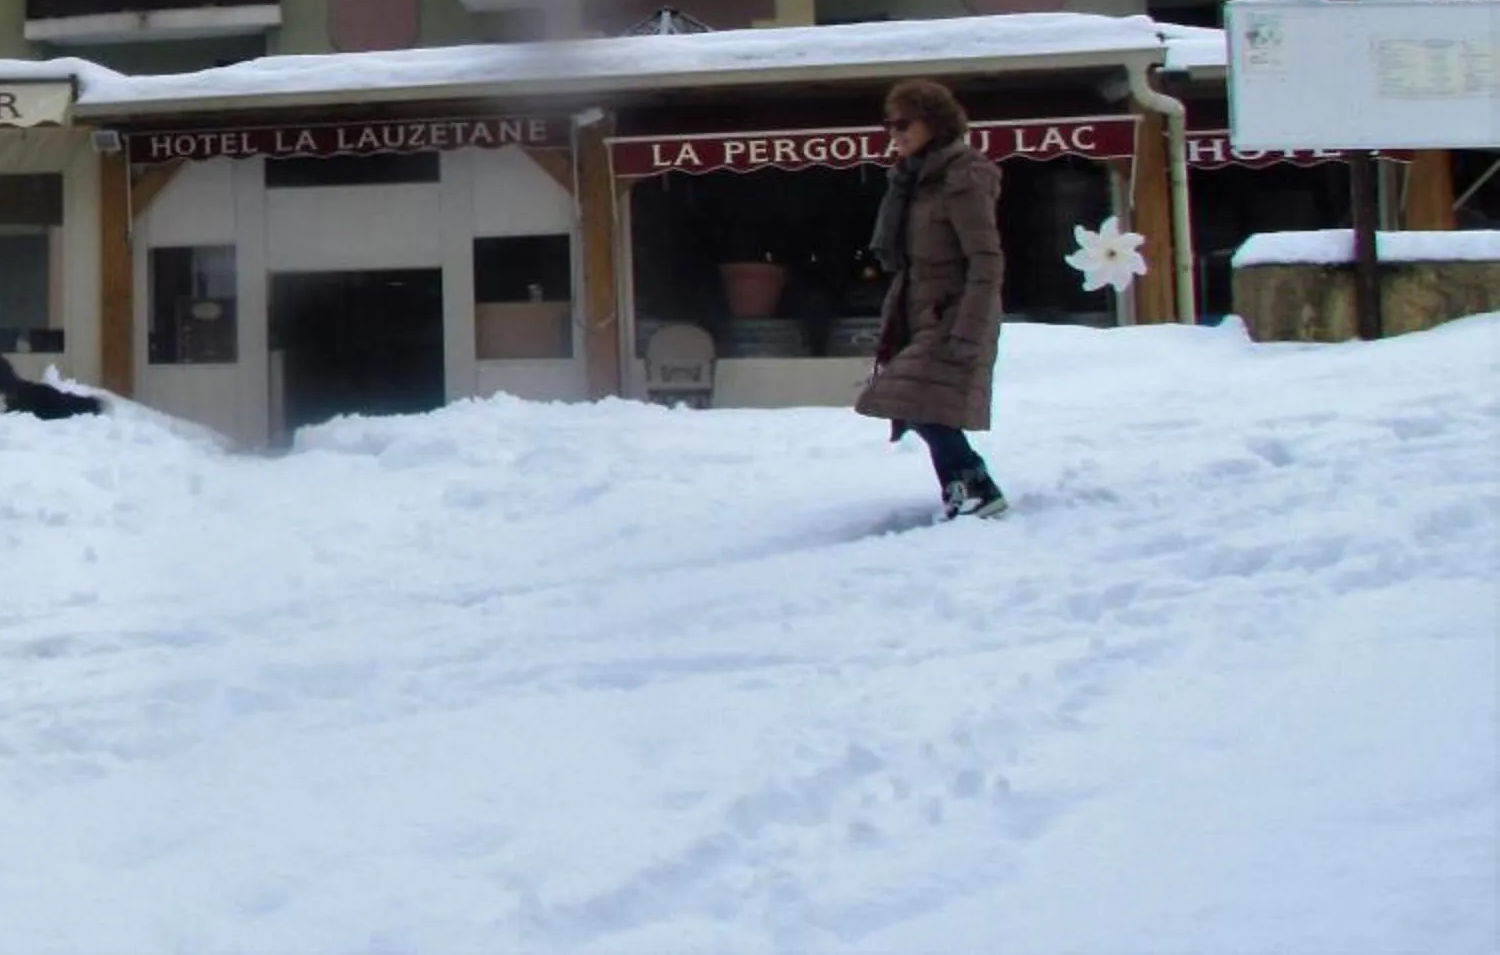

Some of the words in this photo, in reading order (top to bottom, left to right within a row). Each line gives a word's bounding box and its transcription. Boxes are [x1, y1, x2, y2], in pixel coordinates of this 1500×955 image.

[151, 131, 258, 158] HOTEL
[274, 128, 318, 151] LA
[337, 118, 548, 150] LAUZETANE
[652, 143, 701, 168] LA
[1014, 125, 1097, 153] LAC
